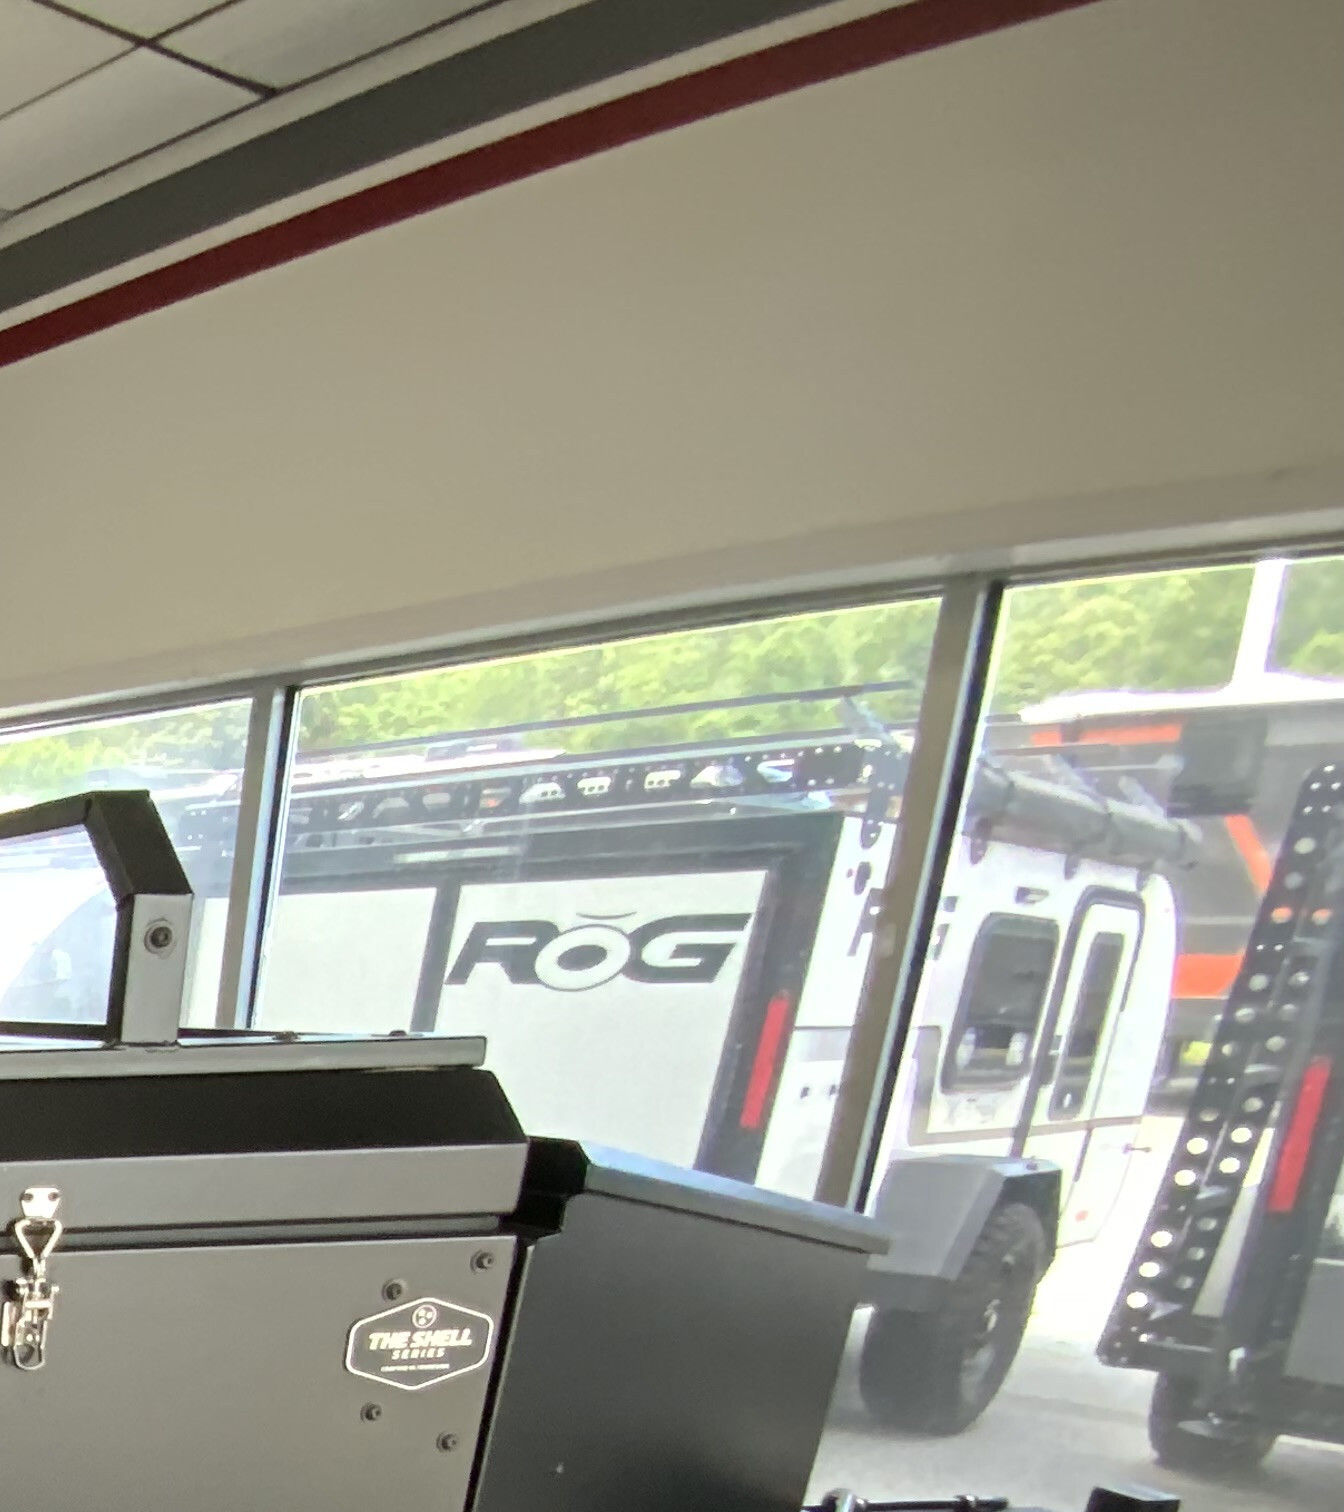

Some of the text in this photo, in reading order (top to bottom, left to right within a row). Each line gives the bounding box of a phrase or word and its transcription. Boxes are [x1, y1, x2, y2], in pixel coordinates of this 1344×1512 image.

[445, 911, 753, 992] ROG
[368, 1327, 473, 1351] THE SHELL
[391, 1347, 446, 1361] SERIES
